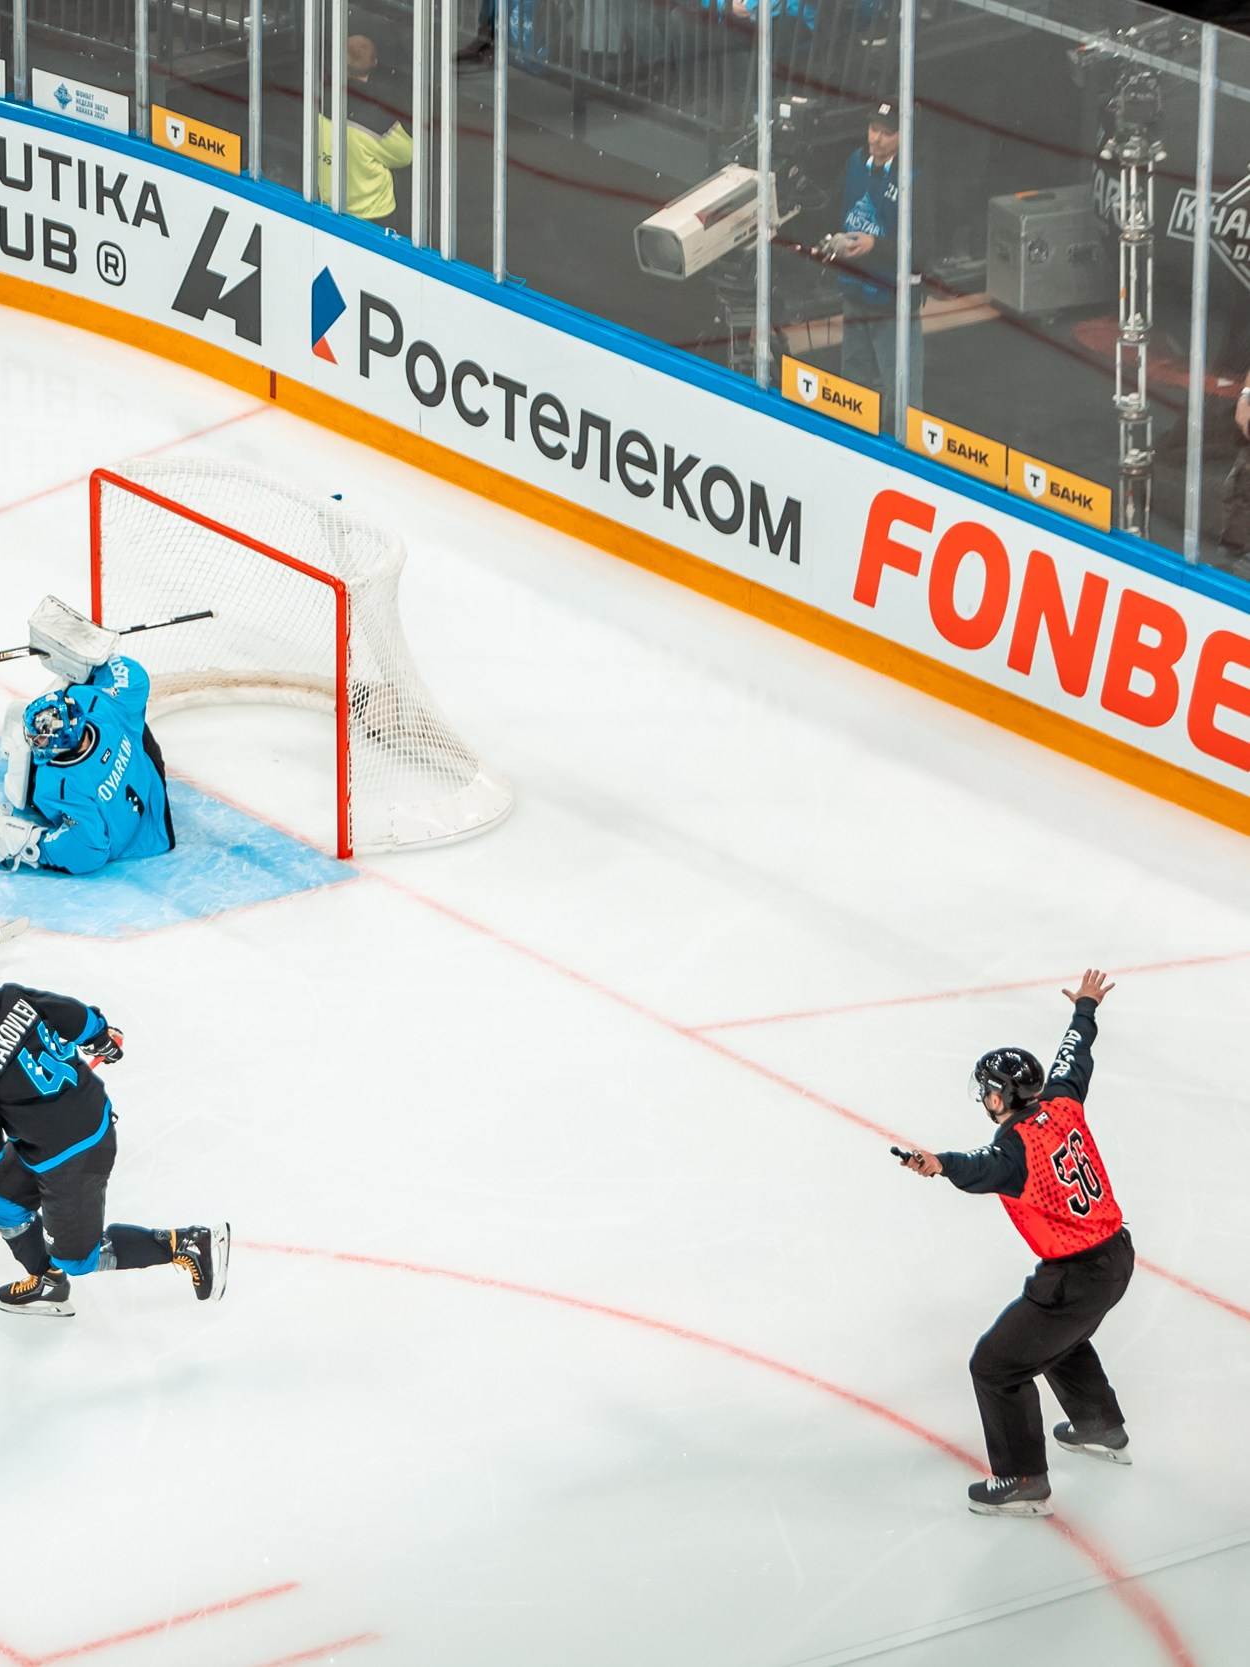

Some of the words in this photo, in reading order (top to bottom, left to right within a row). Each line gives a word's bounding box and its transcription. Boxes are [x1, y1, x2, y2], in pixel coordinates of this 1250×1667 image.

[188, 131, 226, 157] БАНК
[1175, 196, 1250, 240] KHA
[822, 386, 863, 415] БАНК
[358, 290, 803, 566] Ростелеком
[947, 438, 989, 468] БАНК
[1050, 481, 1094, 511] БАНК
[97, 734, 132, 803] OYARKIN
[1051, 1127, 1104, 1218] 56
